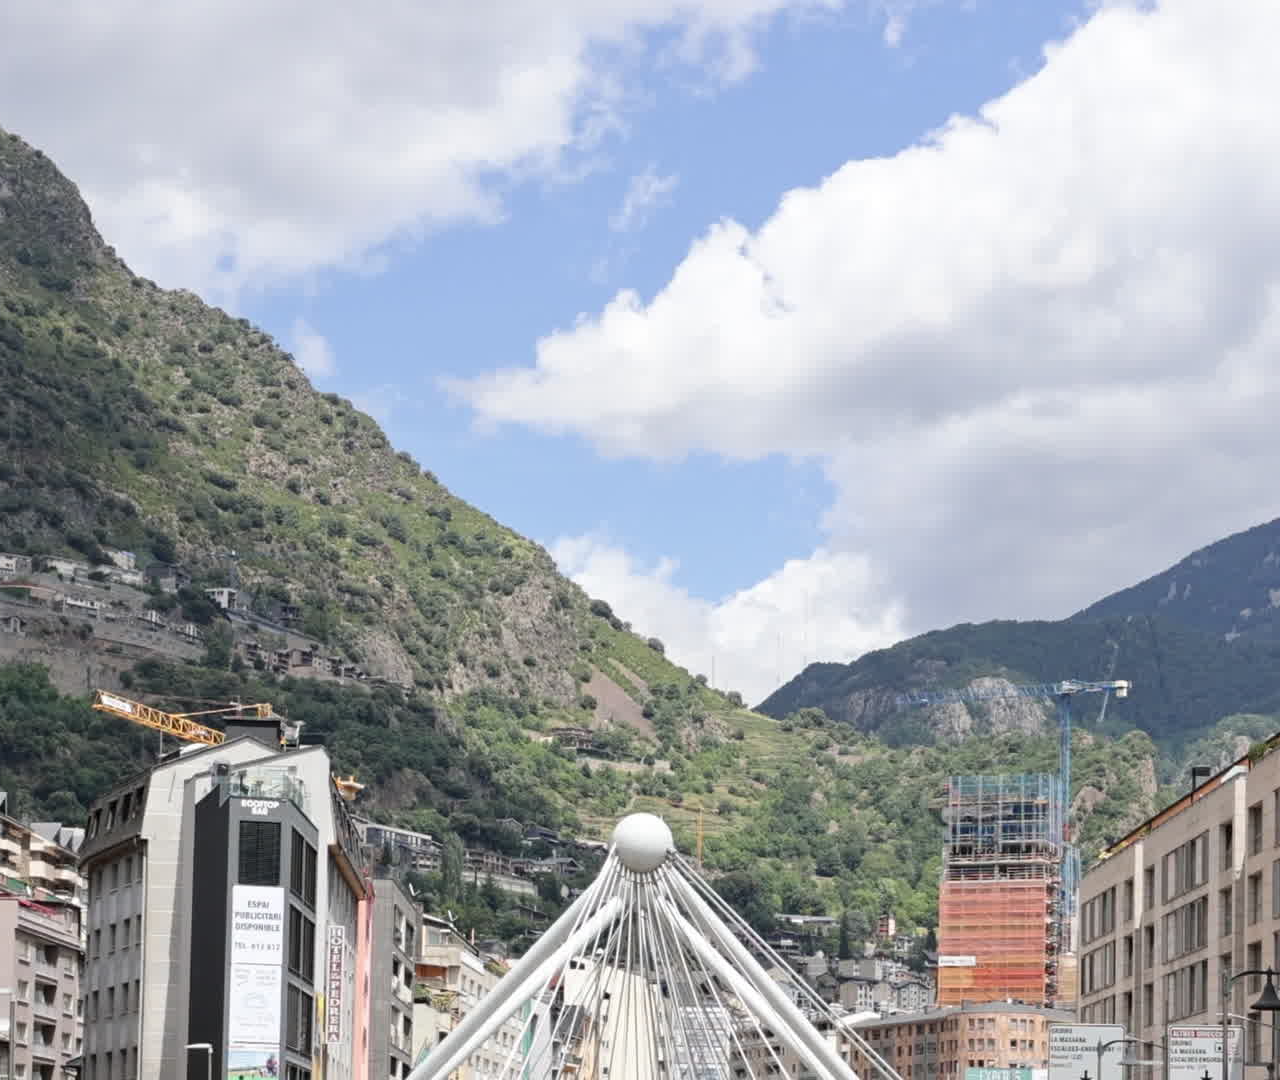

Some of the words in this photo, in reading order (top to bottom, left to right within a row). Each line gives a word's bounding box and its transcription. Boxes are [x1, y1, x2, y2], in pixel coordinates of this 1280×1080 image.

[241, 799, 280, 808] ROOFTOP
[247, 900, 270, 909] ESPAI
[234, 922, 281, 932] DISPONIBLE
